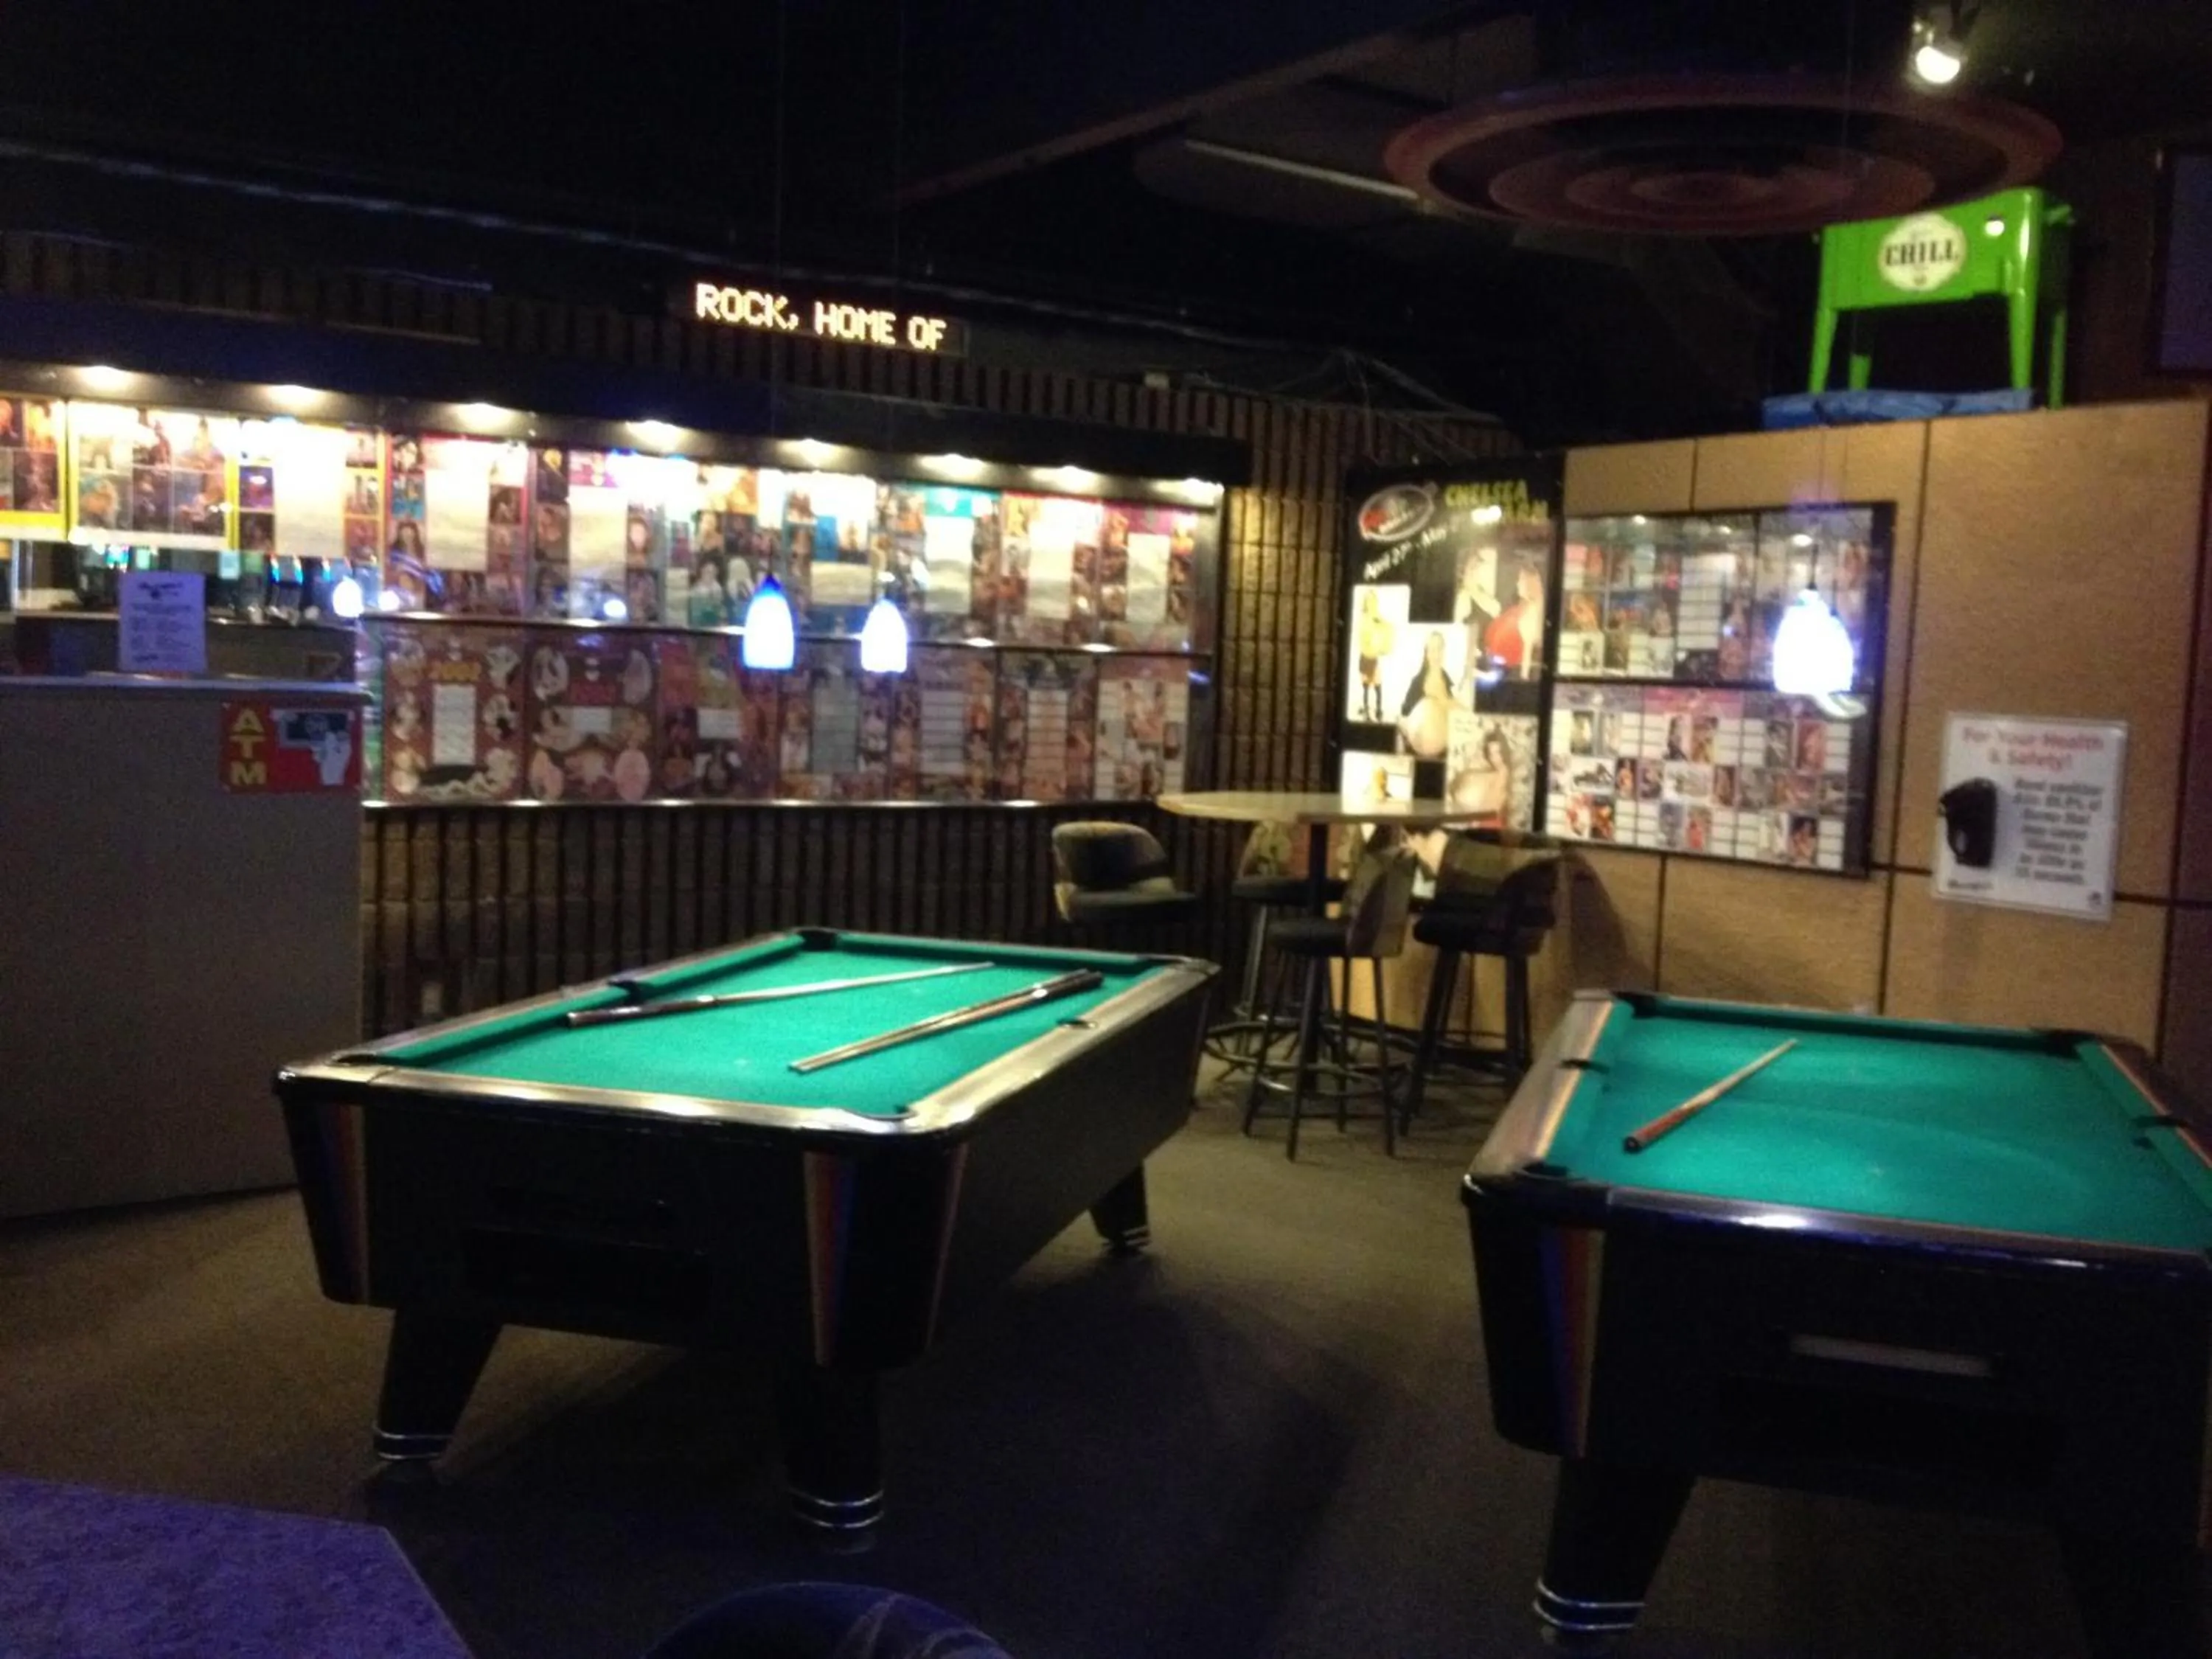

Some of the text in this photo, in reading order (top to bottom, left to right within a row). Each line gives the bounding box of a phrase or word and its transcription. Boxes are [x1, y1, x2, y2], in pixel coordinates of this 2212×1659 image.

[1884, 240, 1959, 266] CHILL
[696, 282, 947, 350] ROCK, HOME OF
[1445, 479, 1528, 507] CHELSEA
[229, 707, 267, 785] ATM
[1962, 726, 2104, 751] For Your Health
